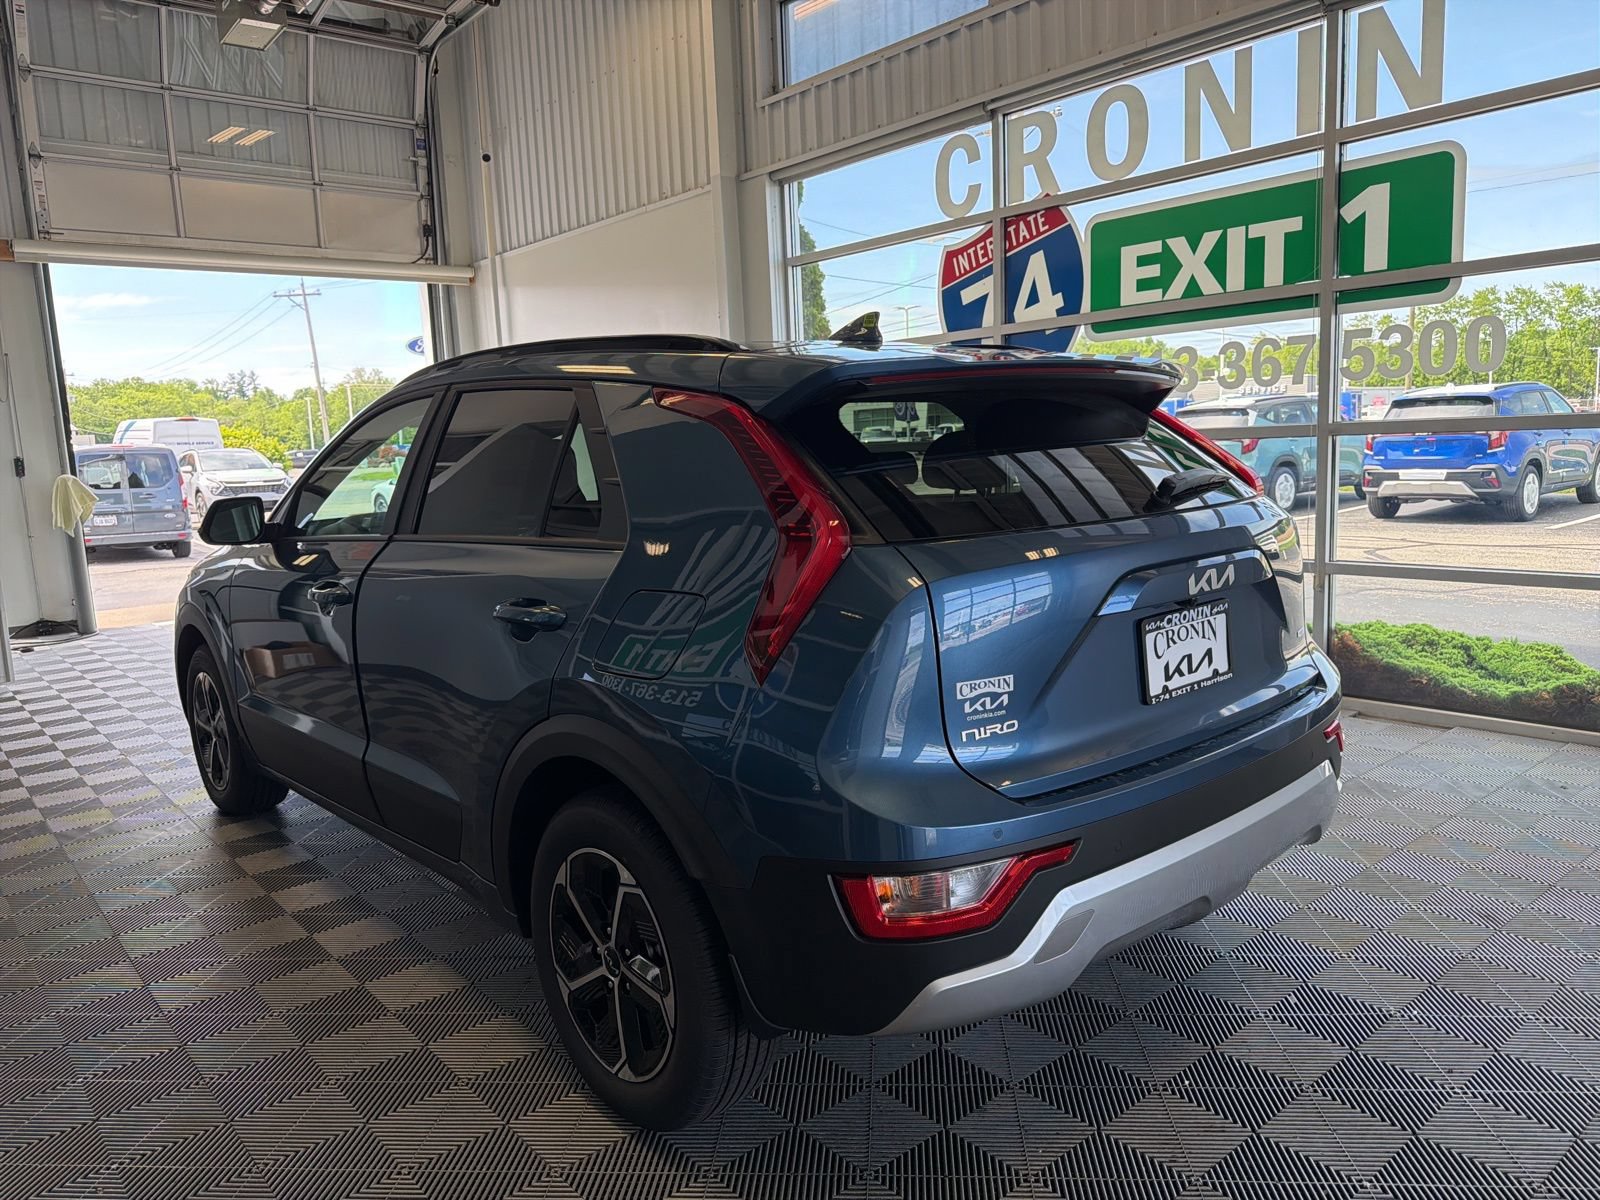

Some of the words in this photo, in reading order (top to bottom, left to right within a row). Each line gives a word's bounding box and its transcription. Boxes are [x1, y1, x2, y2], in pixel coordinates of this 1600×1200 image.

[936, 0, 1445, 218] CRONIN
[953, 210, 1049, 277] INTERTATE
[1120, 216, 1303, 306] EXIT
[1339, 182, 1392, 272] 1
[960, 249, 1065, 344] 74
[1238, 385, 1286, 393] SERVICE
[1189, 564, 1235, 596] KIA
[1163, 604, 1211, 628] CRONIN
[1153, 617, 1217, 660] CRONIN
[1164, 647, 1214, 683] KIA
[959, 676, 1011, 697] CRONIN
[1151, 692, 1170, 705] I-74
[1171, 685, 1192, 698] EXIT
[1193, 683, 1199, 691] 1
[1200, 672, 1233, 688] Harrison
[964, 693, 1009, 714] KIA
[966, 710, 1006, 721] croninkia.com
[961, 719, 1019, 742] NIRO
